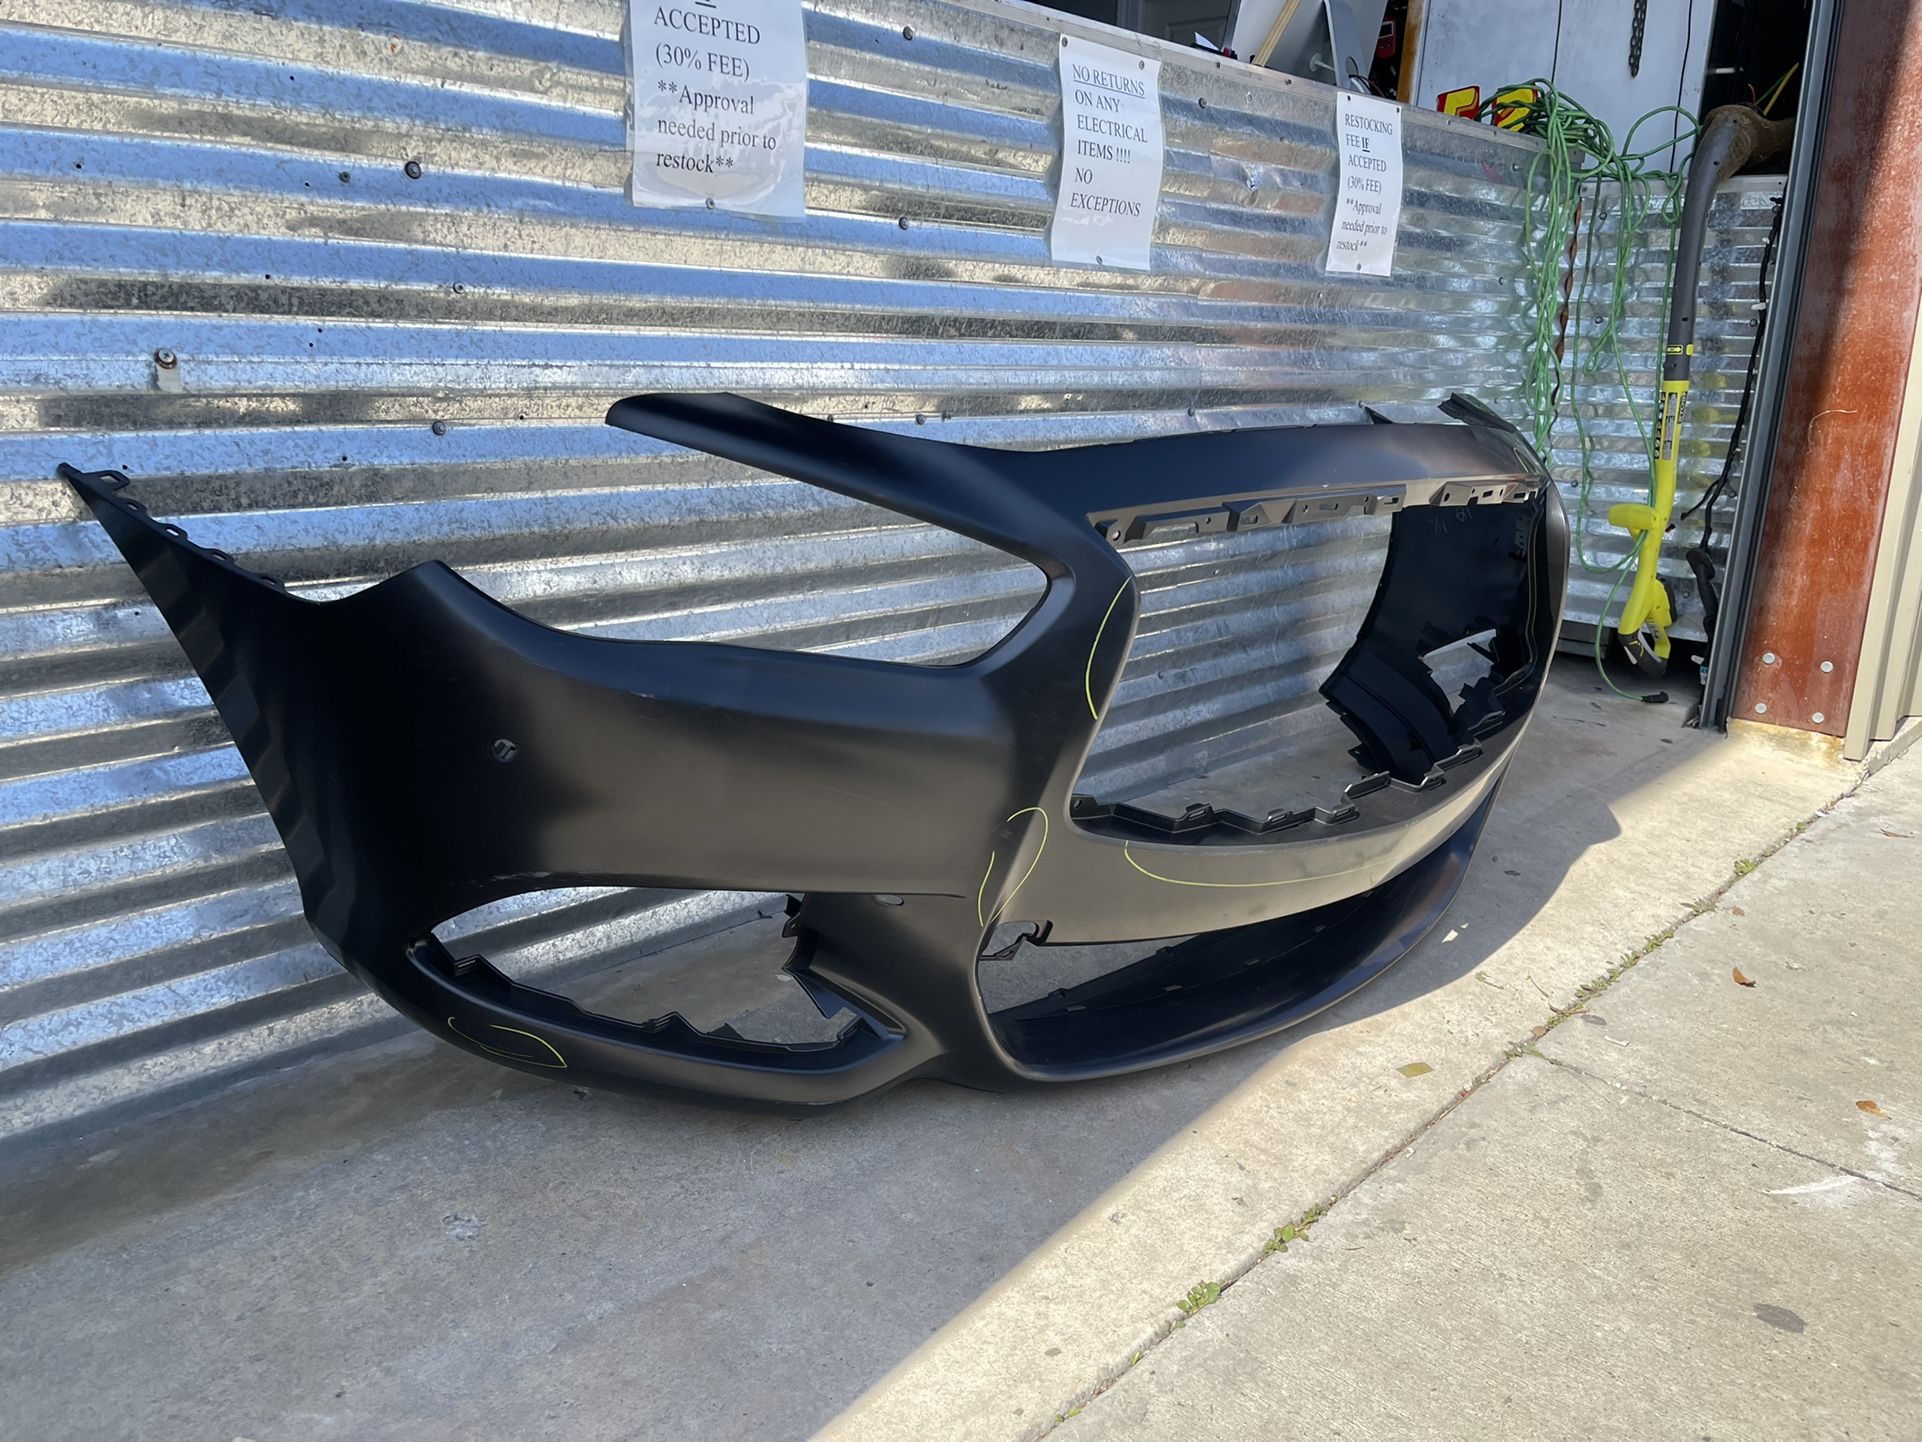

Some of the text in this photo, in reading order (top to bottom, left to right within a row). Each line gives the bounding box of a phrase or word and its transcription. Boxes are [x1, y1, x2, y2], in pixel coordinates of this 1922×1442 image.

[654, 6, 760, 45] ACCEPTED
[656, 43, 750, 82] (30% FEE)
[1072, 63, 1145, 96] NO RETURNS
[1075, 89, 1121, 113] ON ANY
[658, 118, 777, 150] needed prior to
[1077, 114, 1148, 143] ELECTRICAL
[1345, 113, 1392, 136] RESTOCKING
[1077, 139, 1113, 161] ITEMS
[1346, 133, 1370, 150] FEE IF
[1348, 154, 1387, 172] ACCEPTED
[1075, 167, 1093, 184] NO
[1365, 178, 1382, 196] FEE)
[1070, 193, 1141, 217] EXCEPTIONS
[1341, 219, 1388, 236] needed prior to
